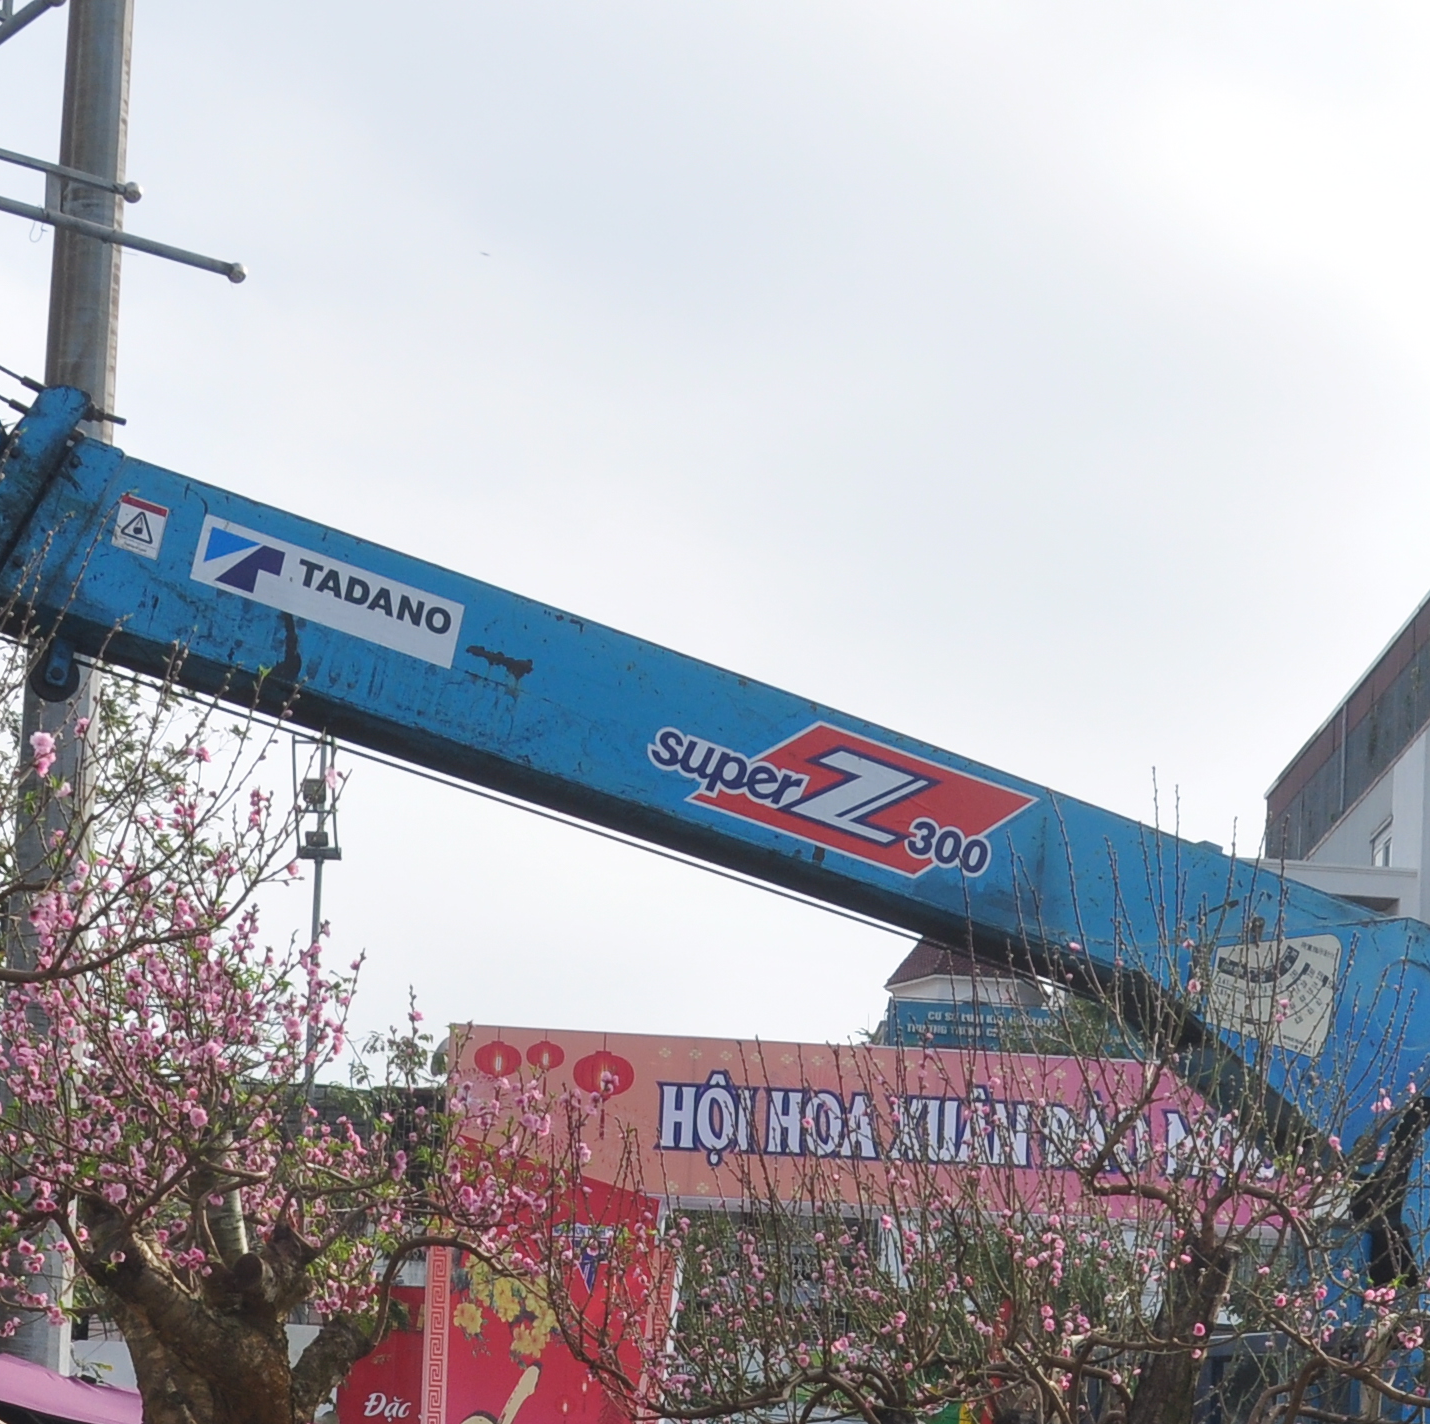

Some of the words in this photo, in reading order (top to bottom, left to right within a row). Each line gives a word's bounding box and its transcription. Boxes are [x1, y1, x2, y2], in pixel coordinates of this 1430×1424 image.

[298, 557, 453, 637] TADANO
[649, 728, 805, 810] super
[905, 819, 991, 876] 300
[656, 1071, 756, 1166] HỘI
[767, 1088, 877, 1160] HOA
[889, 1084, 1031, 1168] XUÂN
[364, 1392, 412, 1422] Đặc
